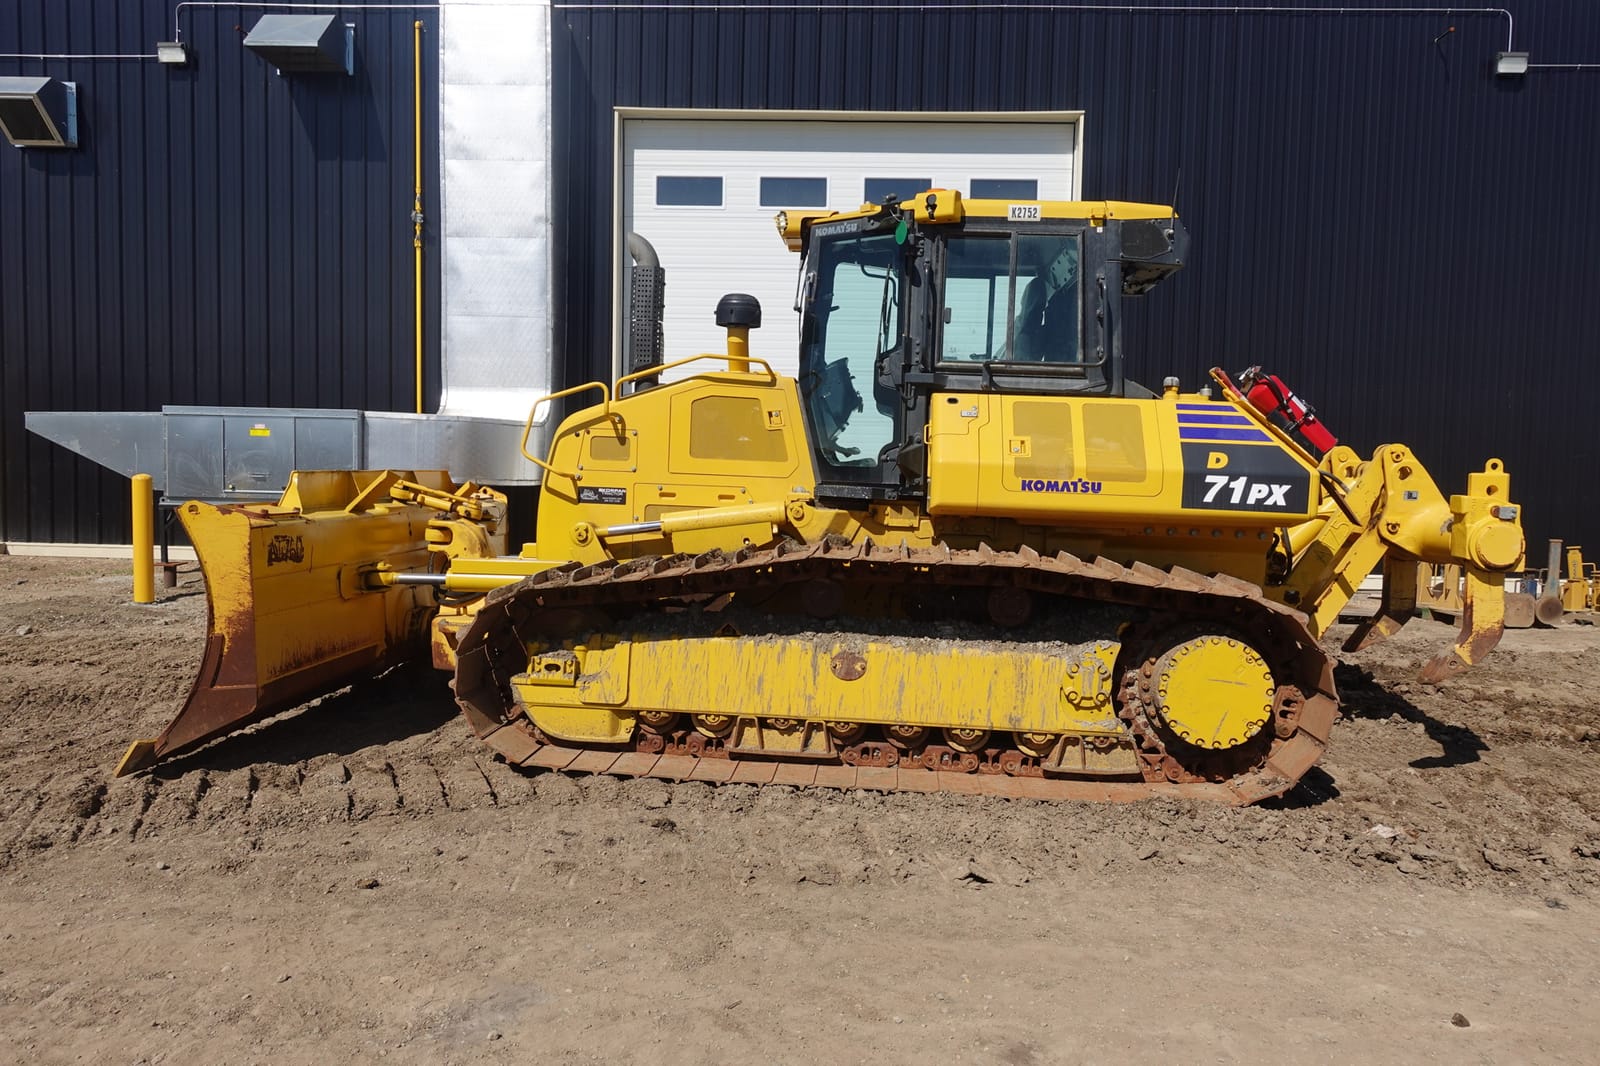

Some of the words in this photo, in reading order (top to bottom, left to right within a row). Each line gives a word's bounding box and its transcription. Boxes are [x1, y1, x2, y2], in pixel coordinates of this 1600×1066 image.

[1011, 207, 1038, 218] K2752
[815, 222, 858, 237] KOMATSU
[1206, 451, 1229, 470] D
[1021, 477, 1102, 494] KOMATSU
[1202, 474, 1292, 506] 71PX
